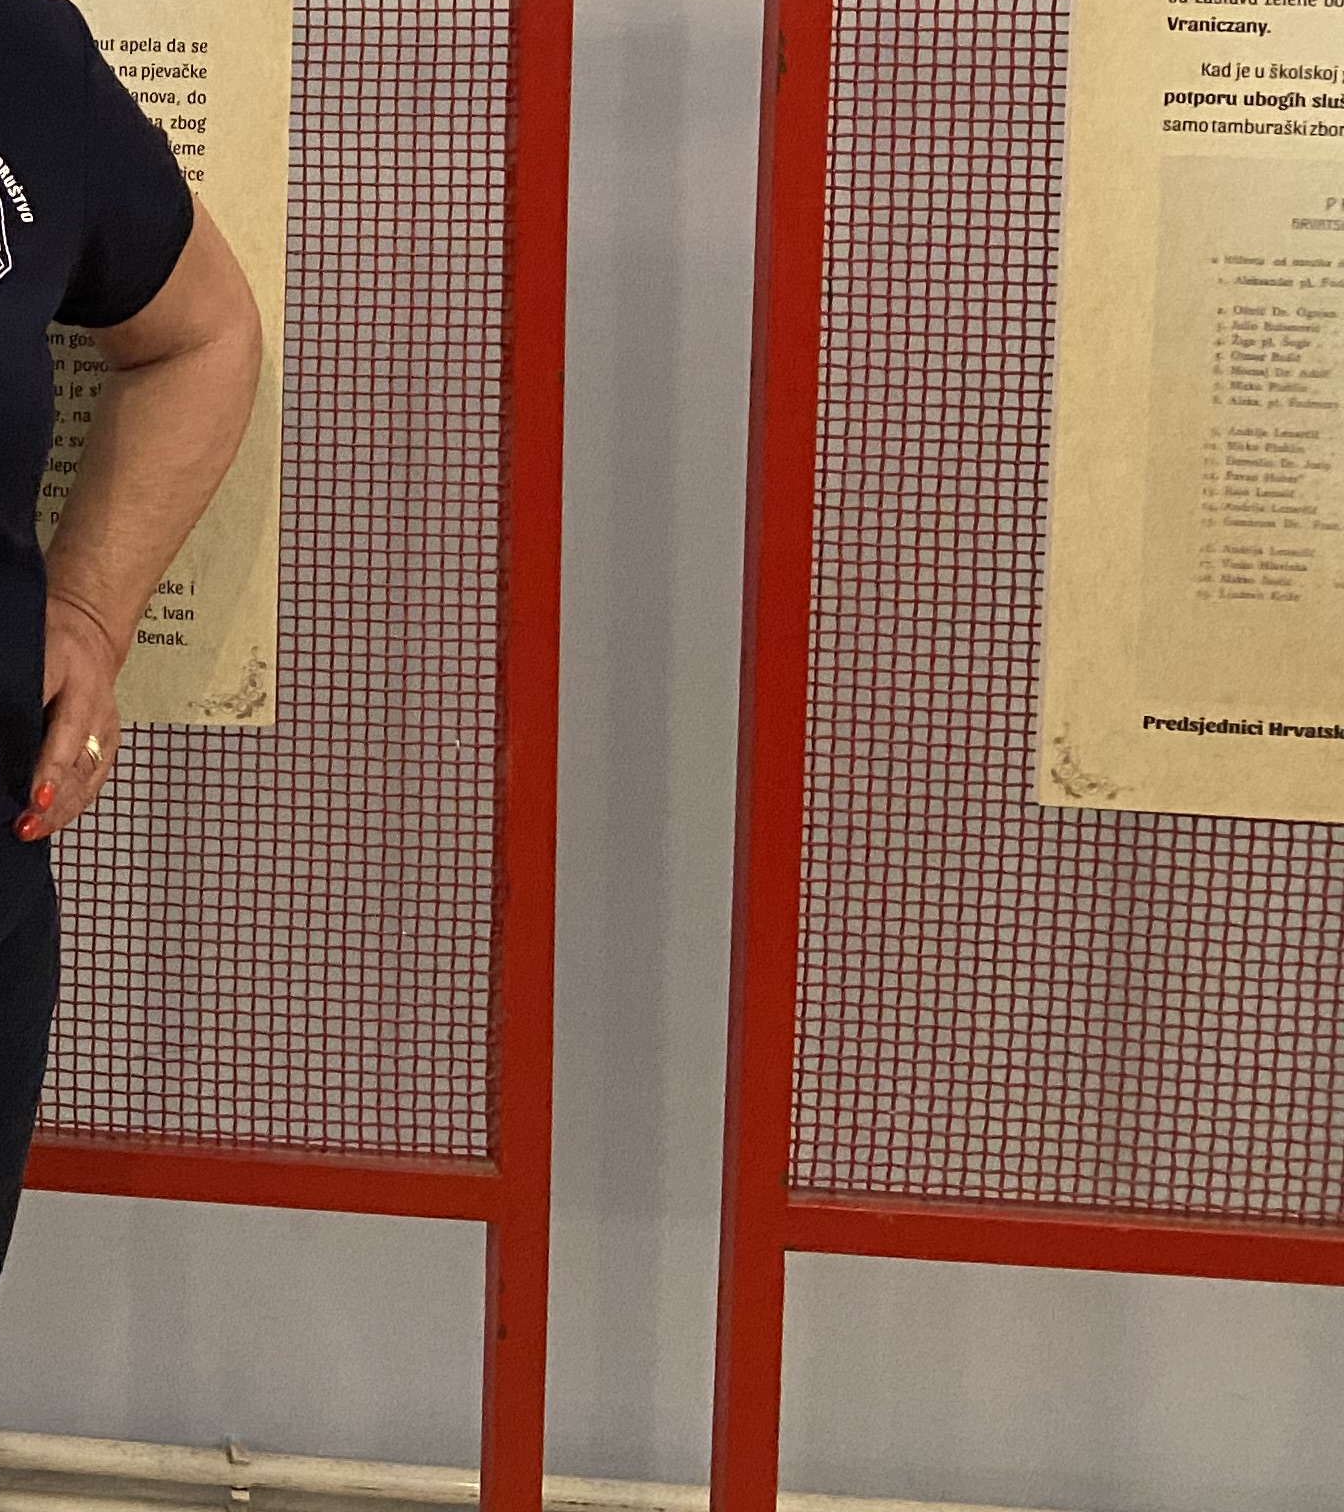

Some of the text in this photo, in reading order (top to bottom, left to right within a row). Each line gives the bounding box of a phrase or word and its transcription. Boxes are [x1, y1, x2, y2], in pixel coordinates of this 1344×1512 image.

[1168, 16, 1272, 37] Vraniczany.
[120, 37, 208, 54] apela da se
[118, 62, 208, 80] na pjevačke
[1164, 90, 1307, 110] potporu ubogih
[137, 629, 188, 646] Benak.
[1143, 715, 1264, 735] Predsjednici
